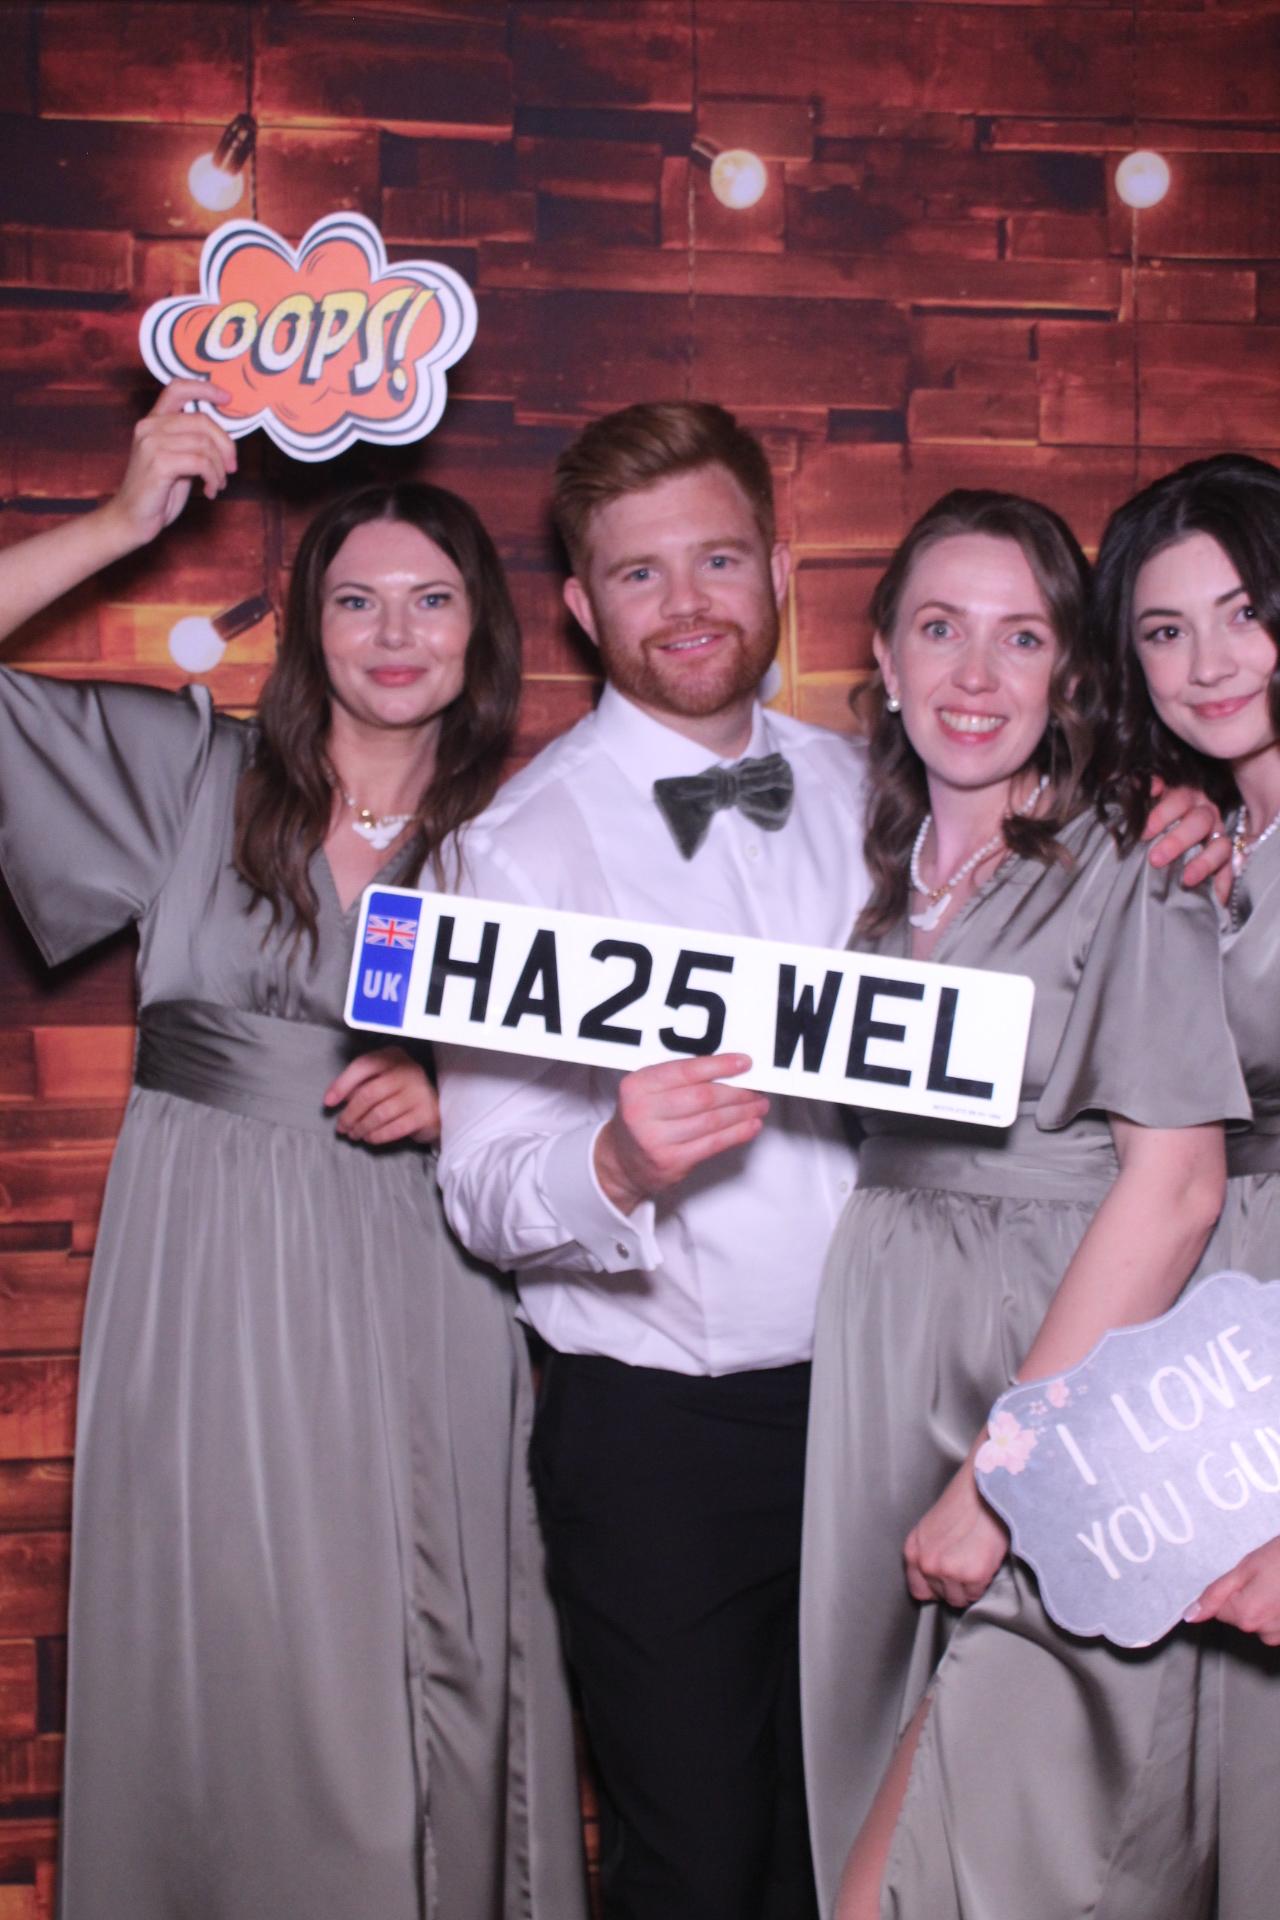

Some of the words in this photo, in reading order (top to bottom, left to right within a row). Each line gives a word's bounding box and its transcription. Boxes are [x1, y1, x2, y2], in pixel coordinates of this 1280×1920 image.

[196, 288, 438, 400] OOPS!
[362, 969, 402, 1003] UK
[423, 914, 734, 1056] HA25
[773, 964, 994, 1099] WEL
[1057, 1424, 1097, 1485] I
[1111, 1326, 1272, 1453] LOVE
[1077, 1481, 1194, 1580] YOU
[1196, 1426, 1280, 1510] GU
